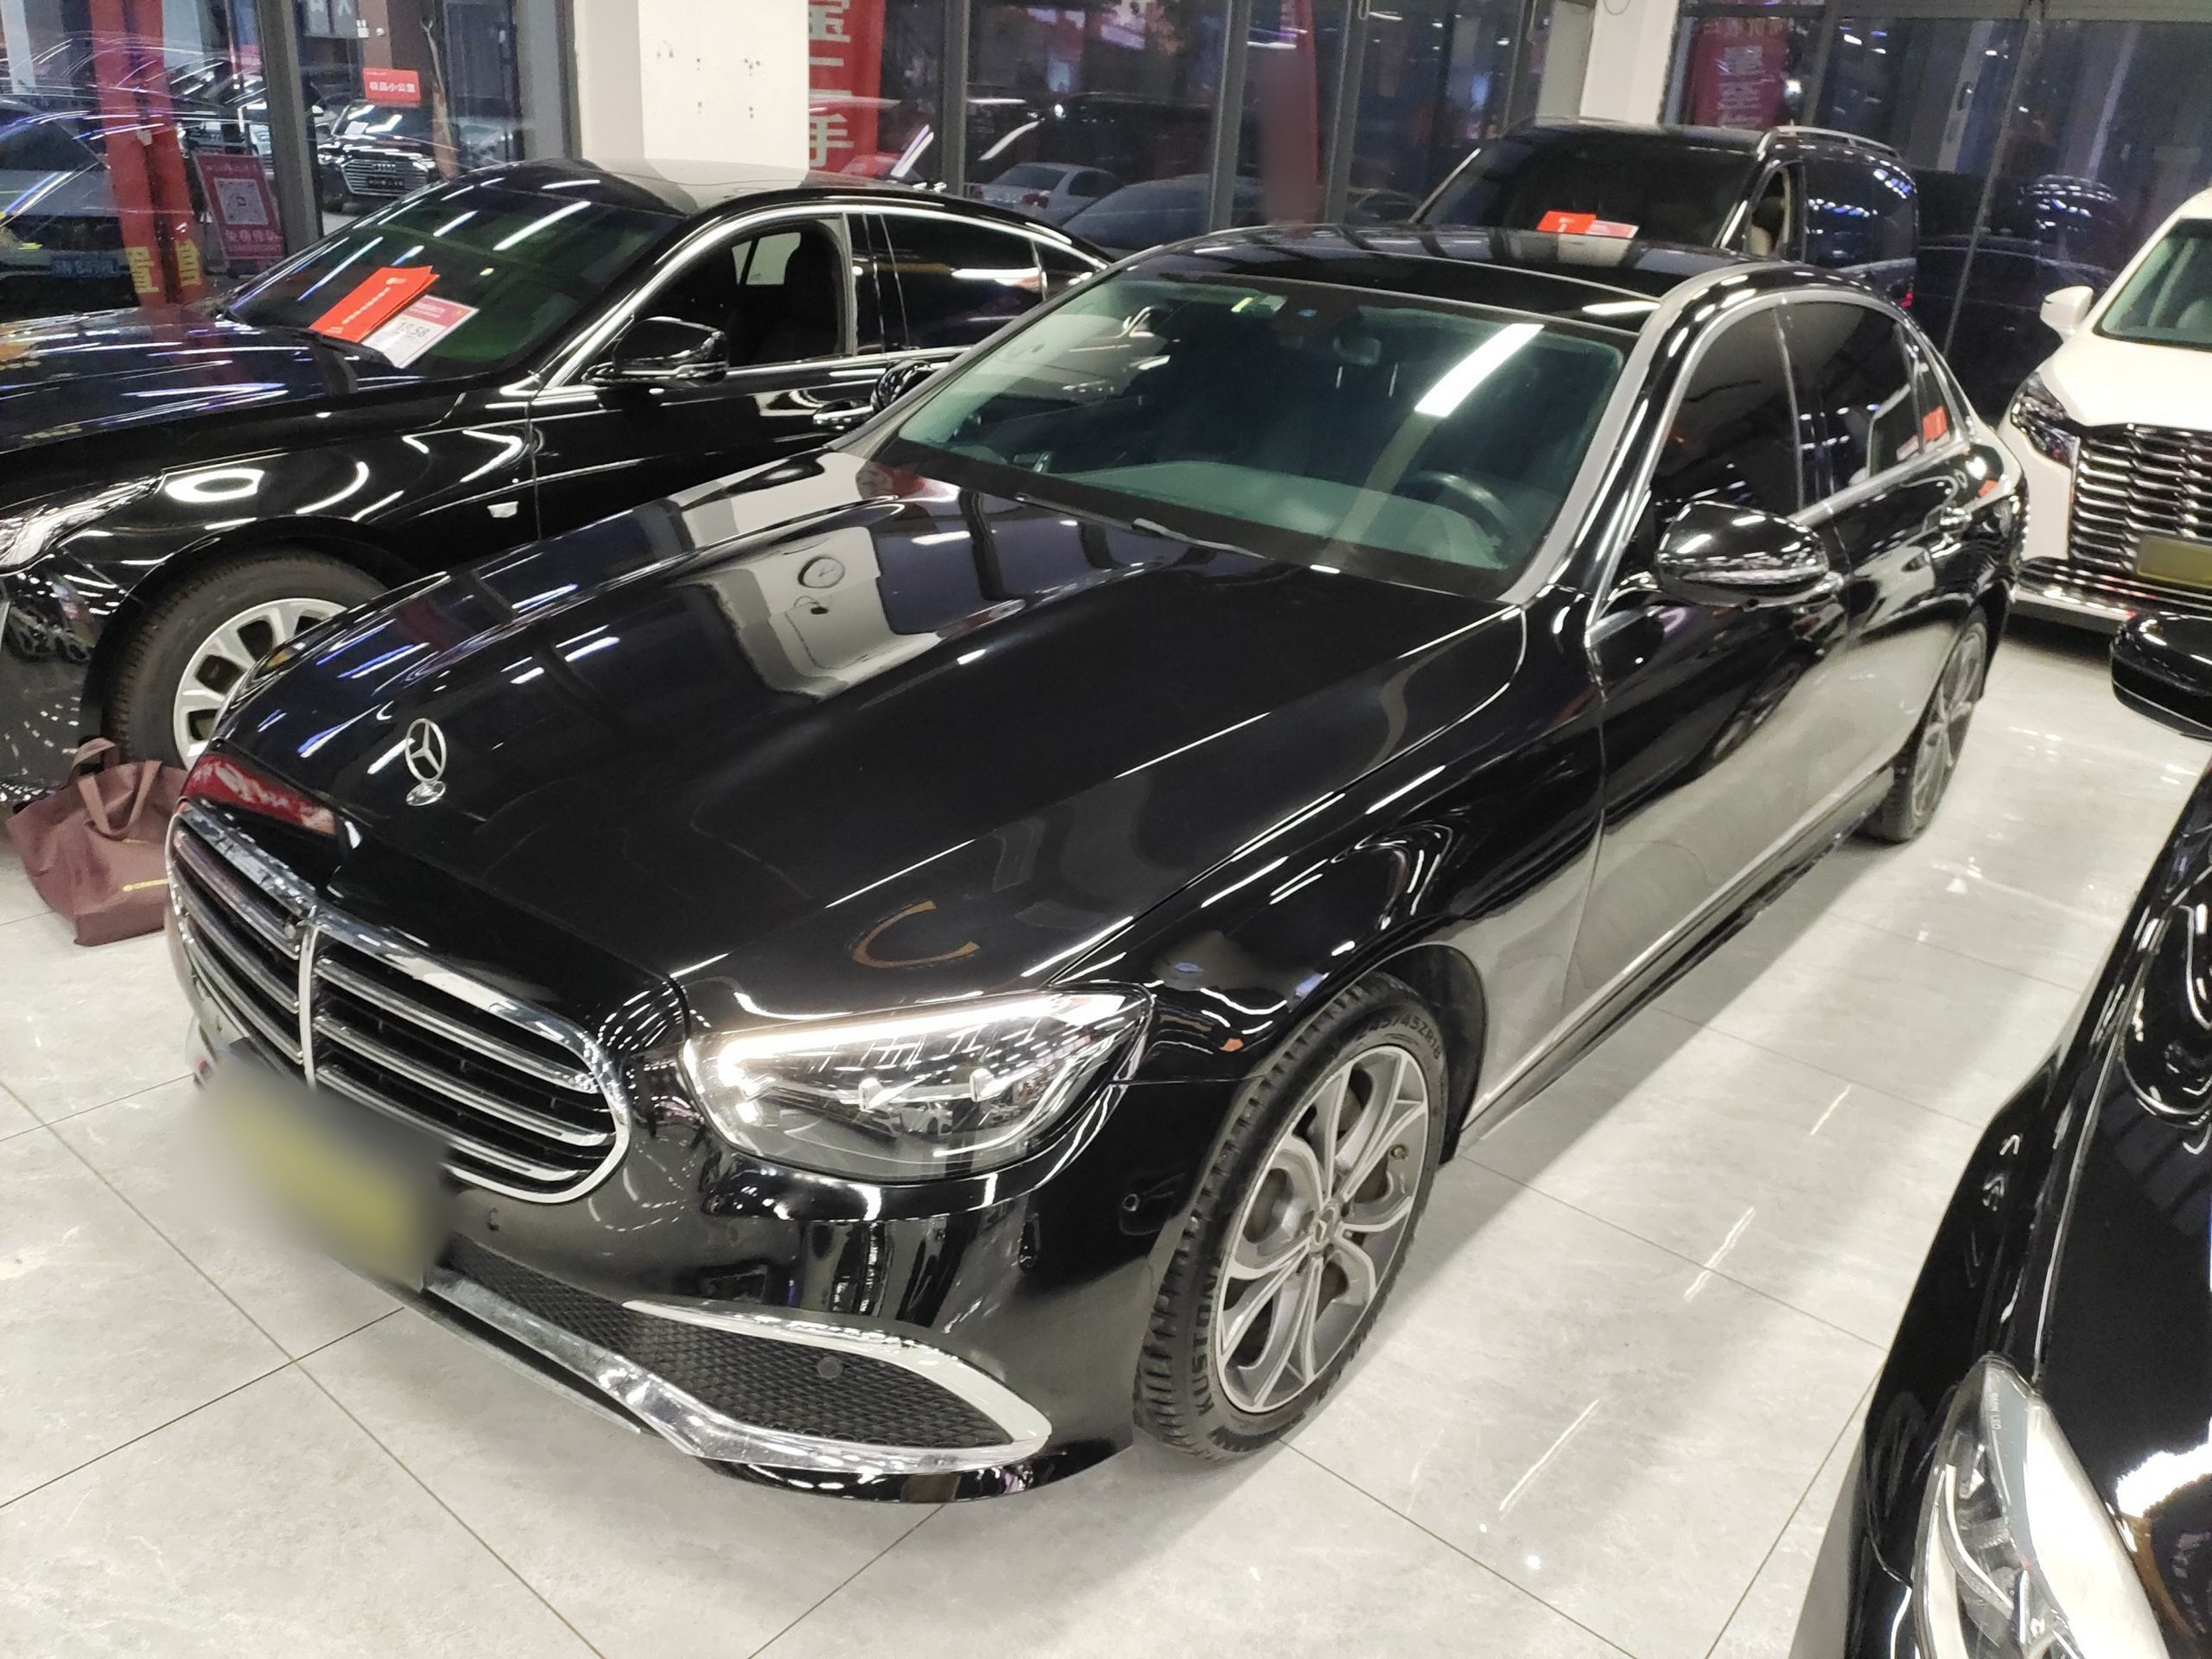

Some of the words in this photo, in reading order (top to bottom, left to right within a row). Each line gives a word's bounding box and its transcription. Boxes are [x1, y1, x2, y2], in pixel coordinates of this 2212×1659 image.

[1355, 1014, 1442, 1059] 5/45ZR18
[1191, 1255, 1221, 1416] KUSTON
[1990, 1414, 2002, 1430] LED
